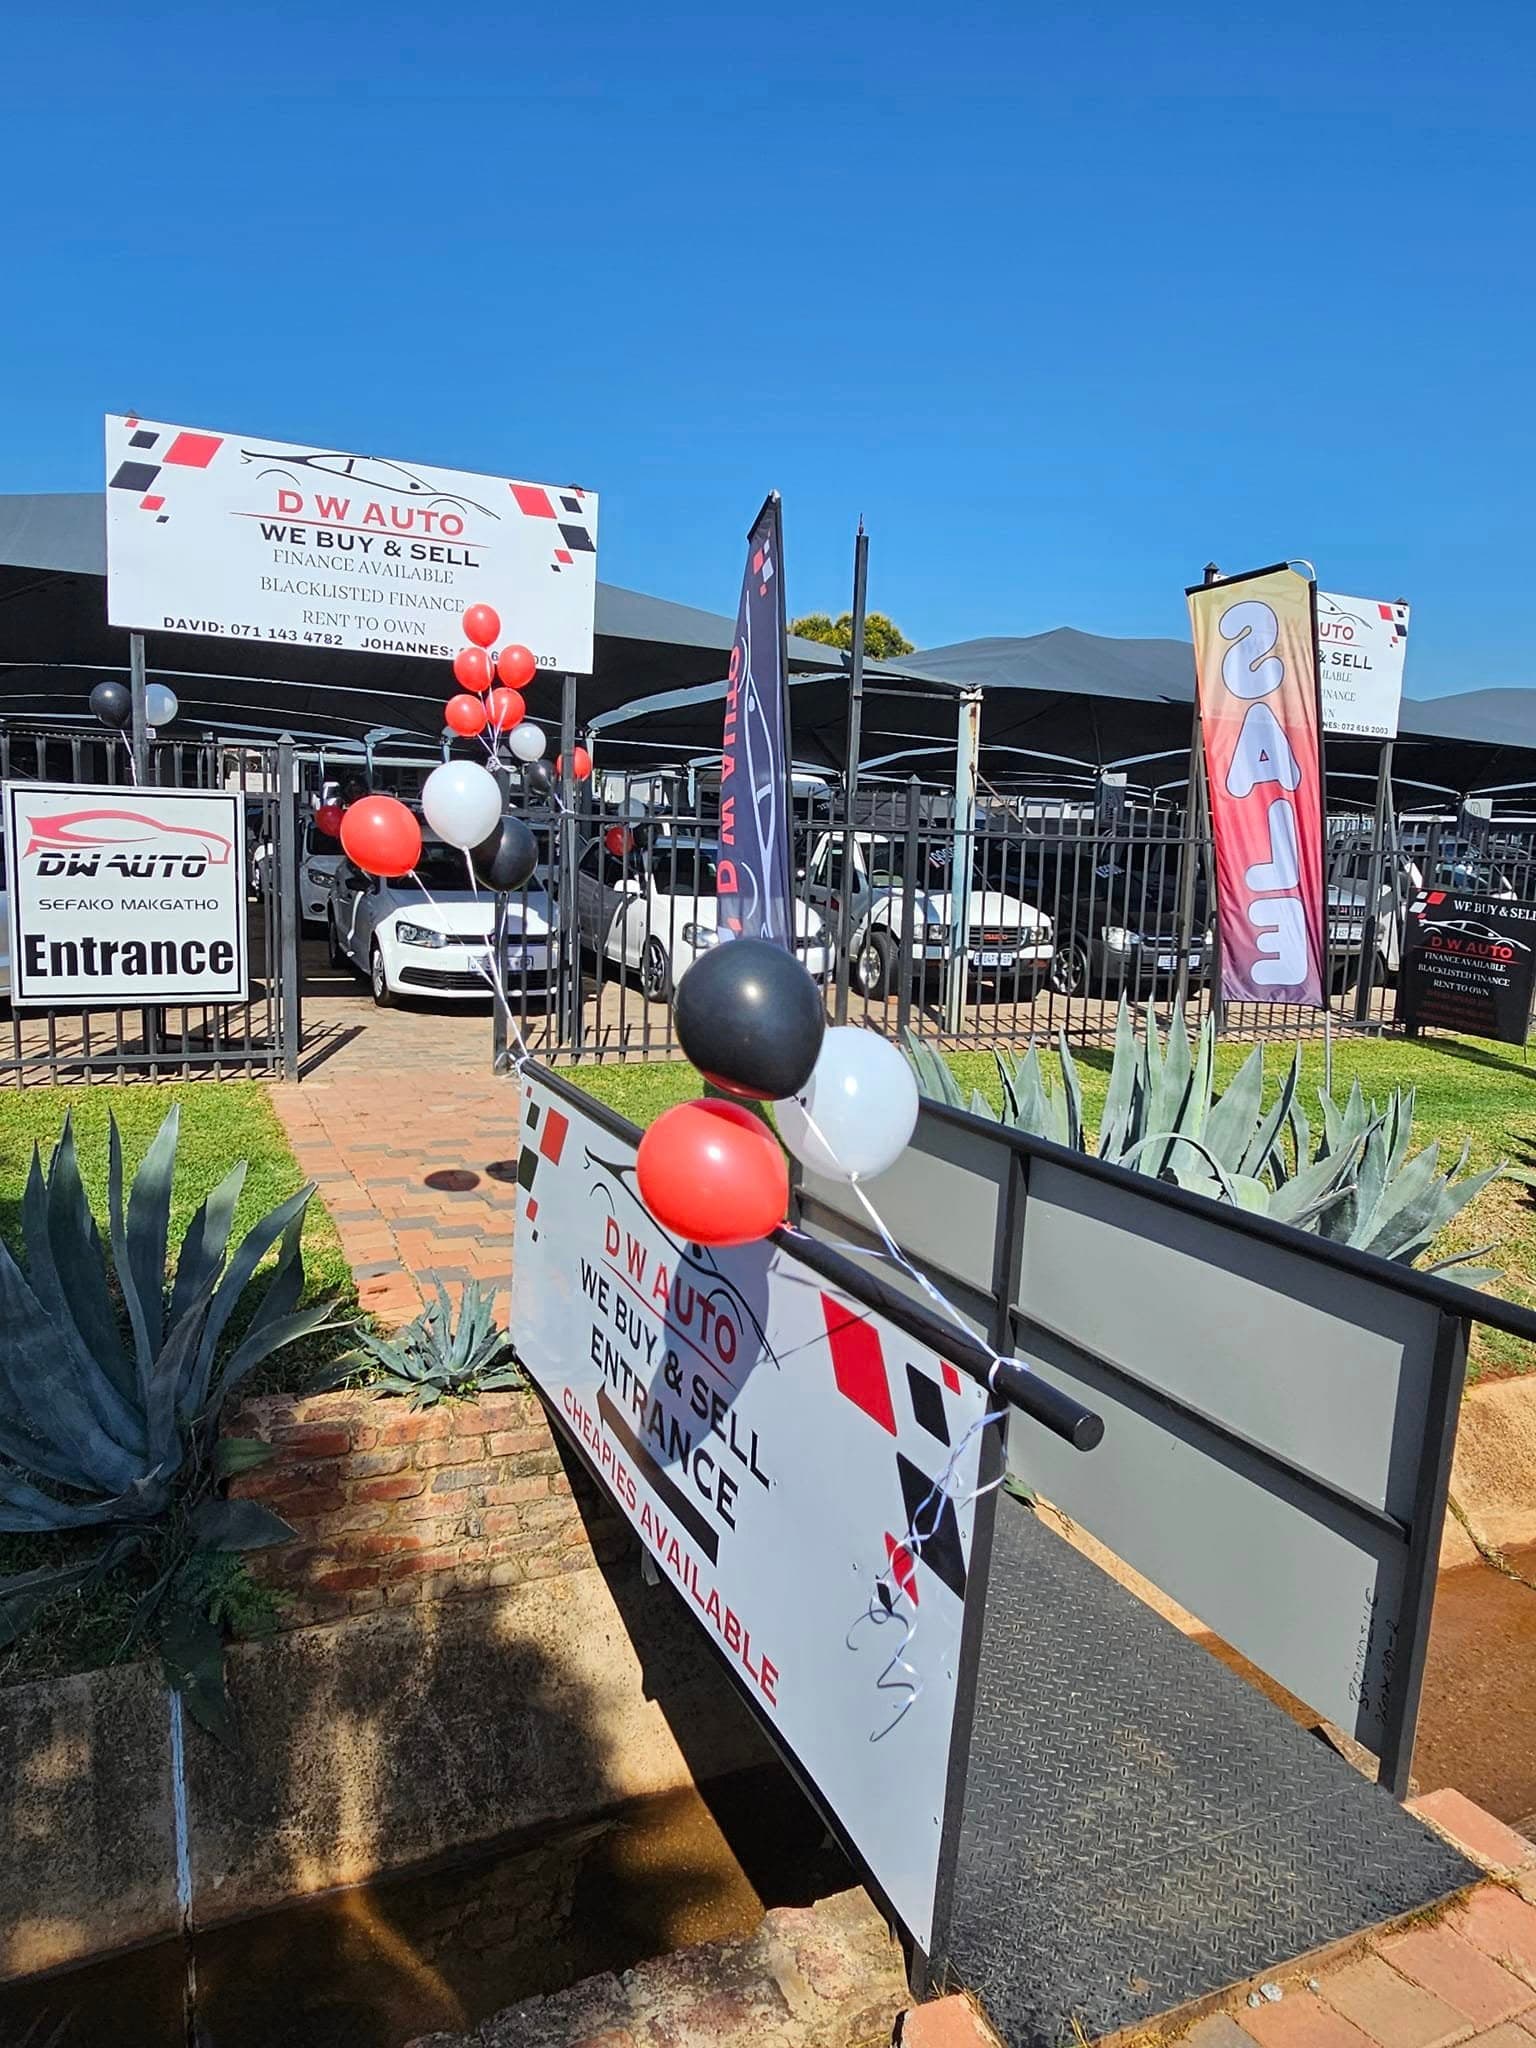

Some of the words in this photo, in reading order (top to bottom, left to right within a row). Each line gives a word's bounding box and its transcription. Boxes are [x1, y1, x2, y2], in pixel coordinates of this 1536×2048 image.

[278, 489, 304, 513] D
[314, 494, 350, 520] W
[362, 502, 464, 537] AUTO
[260, 522, 308, 546] WE
[316, 531, 378, 555] BUY
[383, 539, 401, 557] &
[410, 543, 480, 568] SELL
[273, 549, 356, 573] FINANCE
[359, 559, 454, 585] AVAILABLE
[260, 576, 384, 604] BLACKLISTED
[389, 591, 465, 614] FINANCE
[302, 610, 351, 630] RENT
[354, 615, 380, 632] TO
[382, 618, 427, 637] OWN
[1320, 623, 1354, 640] UTO
[163, 617, 225, 635] DAVID:
[230, 624, 261, 639] 071
[267, 628, 299, 642] 143
[303, 631, 344, 646] 4782
[360, 637, 454, 659] JOHANNES:
[533, 655, 558, 668] 003
[1318, 650, 1327, 663] &
[1331, 652, 1373, 670] SELL
[1322, 671, 1353, 683] ILABLE
[1324, 691, 1357, 702] NANCE
[1342, 722, 1356, 732] 072
[1371, 726, 1389, 735] 2003
[36, 853, 101, 877] DW
[106, 855, 208, 877] AUTO
[39, 899, 114, 911] SEFAKO
[121, 899, 219, 911] MAKGATHO
[1454, 900, 1473, 912] WE
[1474, 903, 1498, 916] BUY
[1499, 907, 1508, 917] &
[24, 934, 234, 977] Entrance
[1431, 936, 1442, 947] D
[1447, 939, 1464, 950] W
[1466, 942, 1513, 959] AUTO
[1424, 952, 1462, 965] FINANCE
[1462, 958, 1507, 973] AVAILABLE
[1418, 964, 1472, 980] BLACKLISTED
[1473, 973, 1511, 987] FINANCE
[1433, 979, 1457, 991] RENT
[1457, 983, 1468, 992] TO
[1469, 986, 1489, 996] OWN
[604, 1215, 621, 1258] D
[627, 1236, 648, 1282] W
[652, 1263, 737, 1365] AUTO
[580, 1257, 611, 1303] WE
[614, 1286, 657, 1363] BUY
[664, 1350, 684, 1392] &
[689, 1373, 772, 1492] SELL
[590, 1323, 739, 1531] ENTRANCE
[562, 1386, 638, 1512] CHEAPIES
[640, 1502, 780, 1708] AVAILABLE
